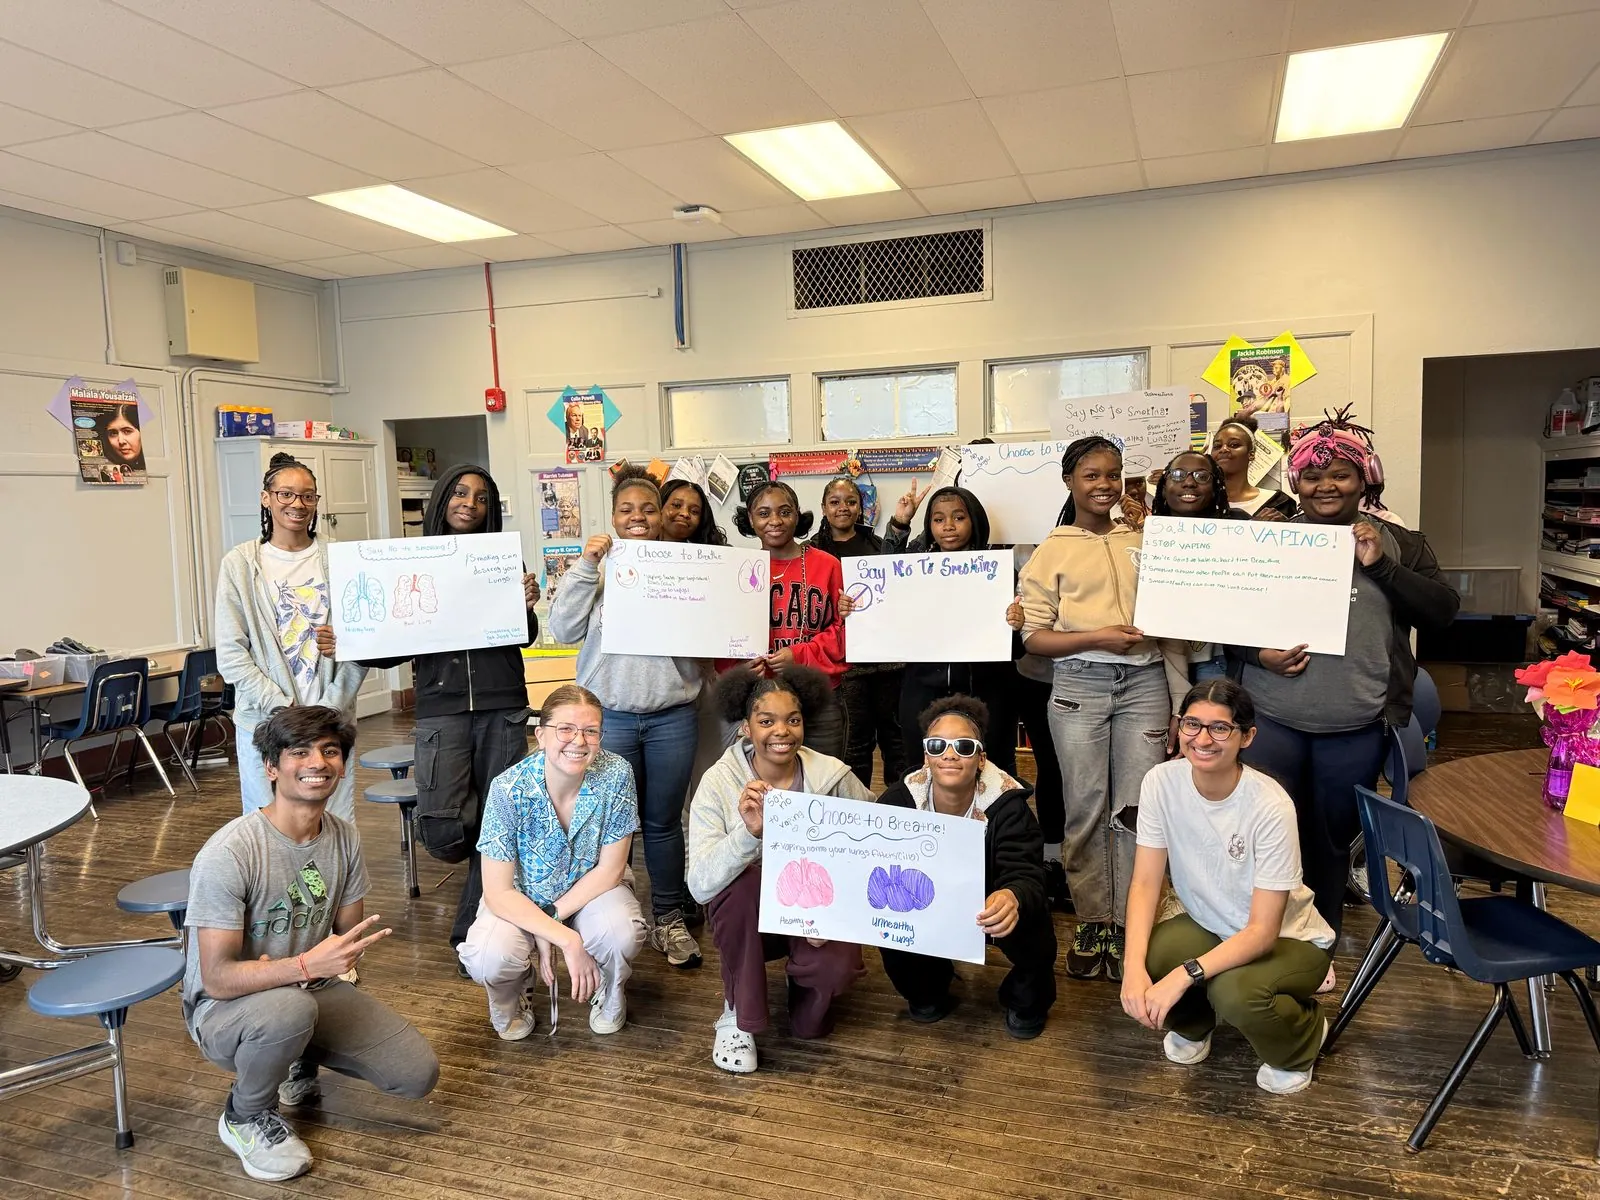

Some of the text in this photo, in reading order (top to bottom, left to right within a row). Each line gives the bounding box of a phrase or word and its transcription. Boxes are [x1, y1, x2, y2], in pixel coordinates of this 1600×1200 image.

[71, 388, 136, 400] Malala Yousafzai
[1065, 403, 1086, 422] Say
[1065, 424, 1087, 437] Say
[998, 443, 1035, 460] Choose
[1041, 443, 1051, 456] to
[1152, 539, 1176, 548] STOP
[1179, 542, 1211, 550] VAPING
[1249, 525, 1338, 549] VAPING!
[636, 544, 673, 559] Choose
[680, 548, 692, 560] to
[857, 558, 886, 594] Say
[892, 559, 912, 577] No
[940, 555, 999, 581] Smoking
[808, 799, 946, 835] Choose to Breathe!
[828, 846, 847, 858] your
[849, 846, 870, 859] lungs
